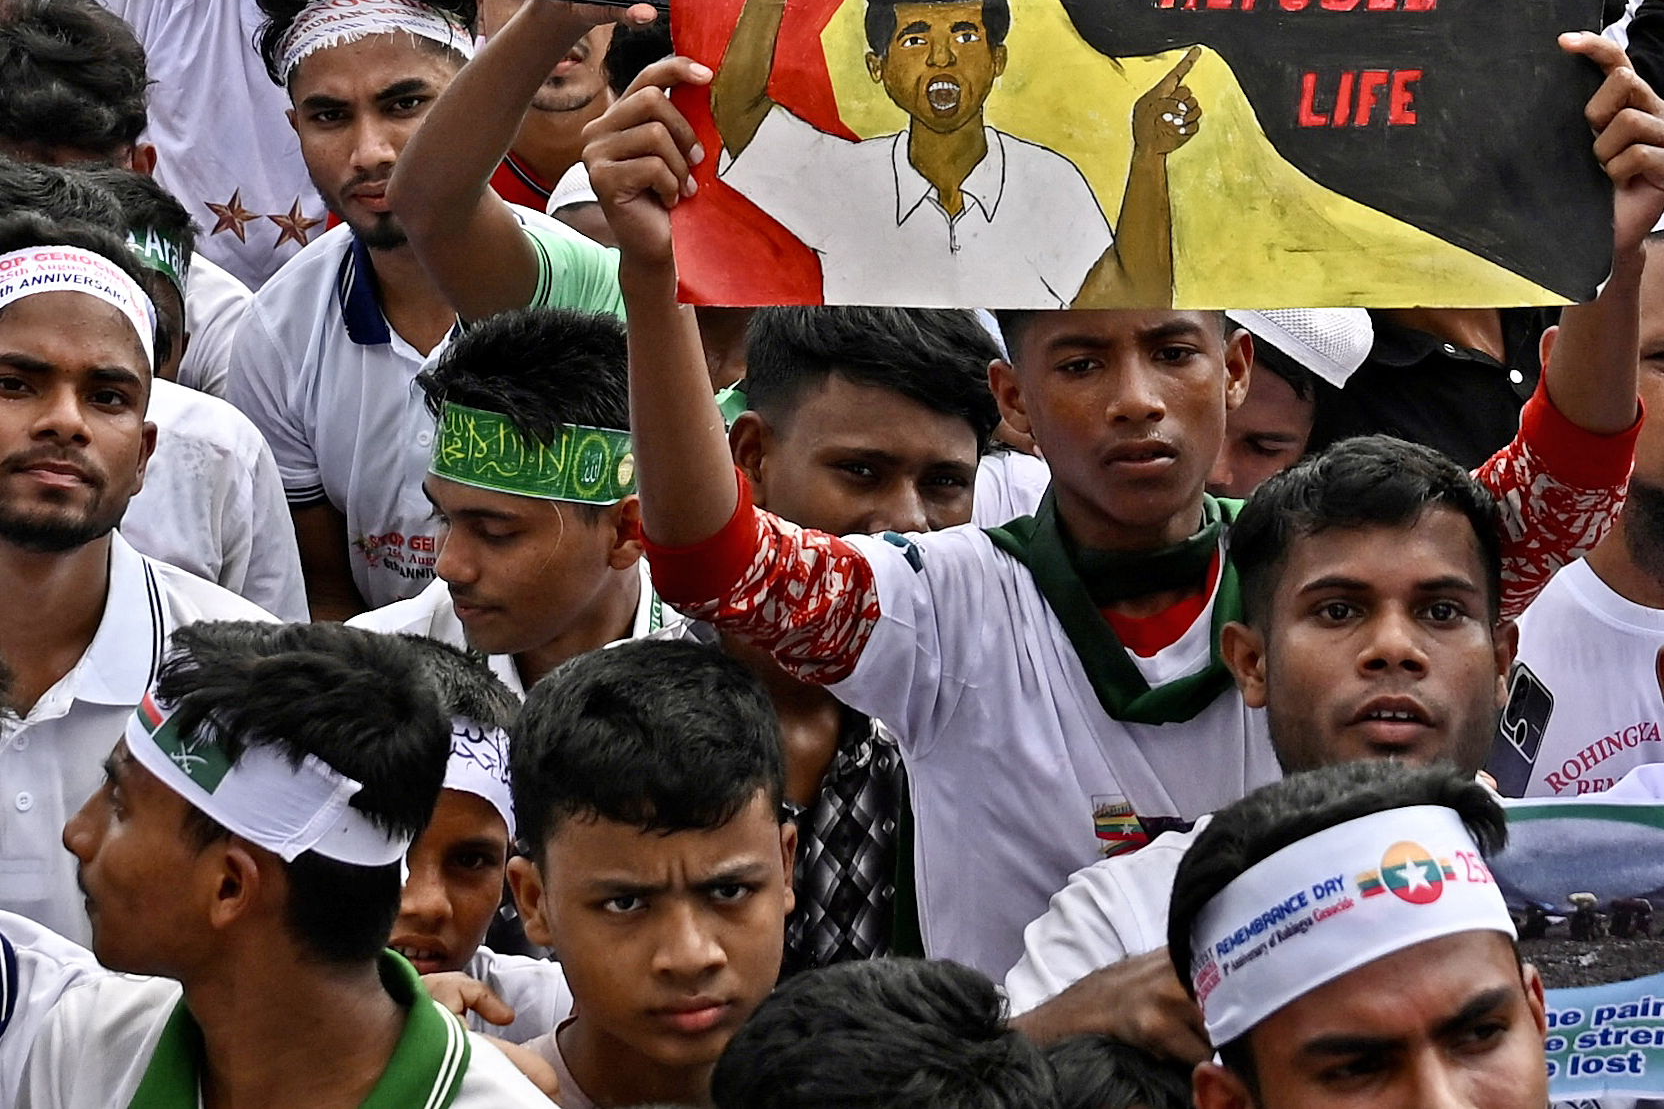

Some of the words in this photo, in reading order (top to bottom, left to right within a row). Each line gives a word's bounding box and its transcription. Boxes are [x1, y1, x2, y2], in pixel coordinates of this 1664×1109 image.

[1298, 69, 1423, 129] LIFE
[0, 256, 26, 271] OP
[0, 284, 14, 299] th
[19, 273, 127, 305] ANNIVERSARY
[1543, 722, 1662, 795] ROHINGYA
[1215, 891, 1309, 959] REMEMBRANCE
[1312, 874, 1345, 901] DAY
[1570, 1052, 1643, 1076] lost
